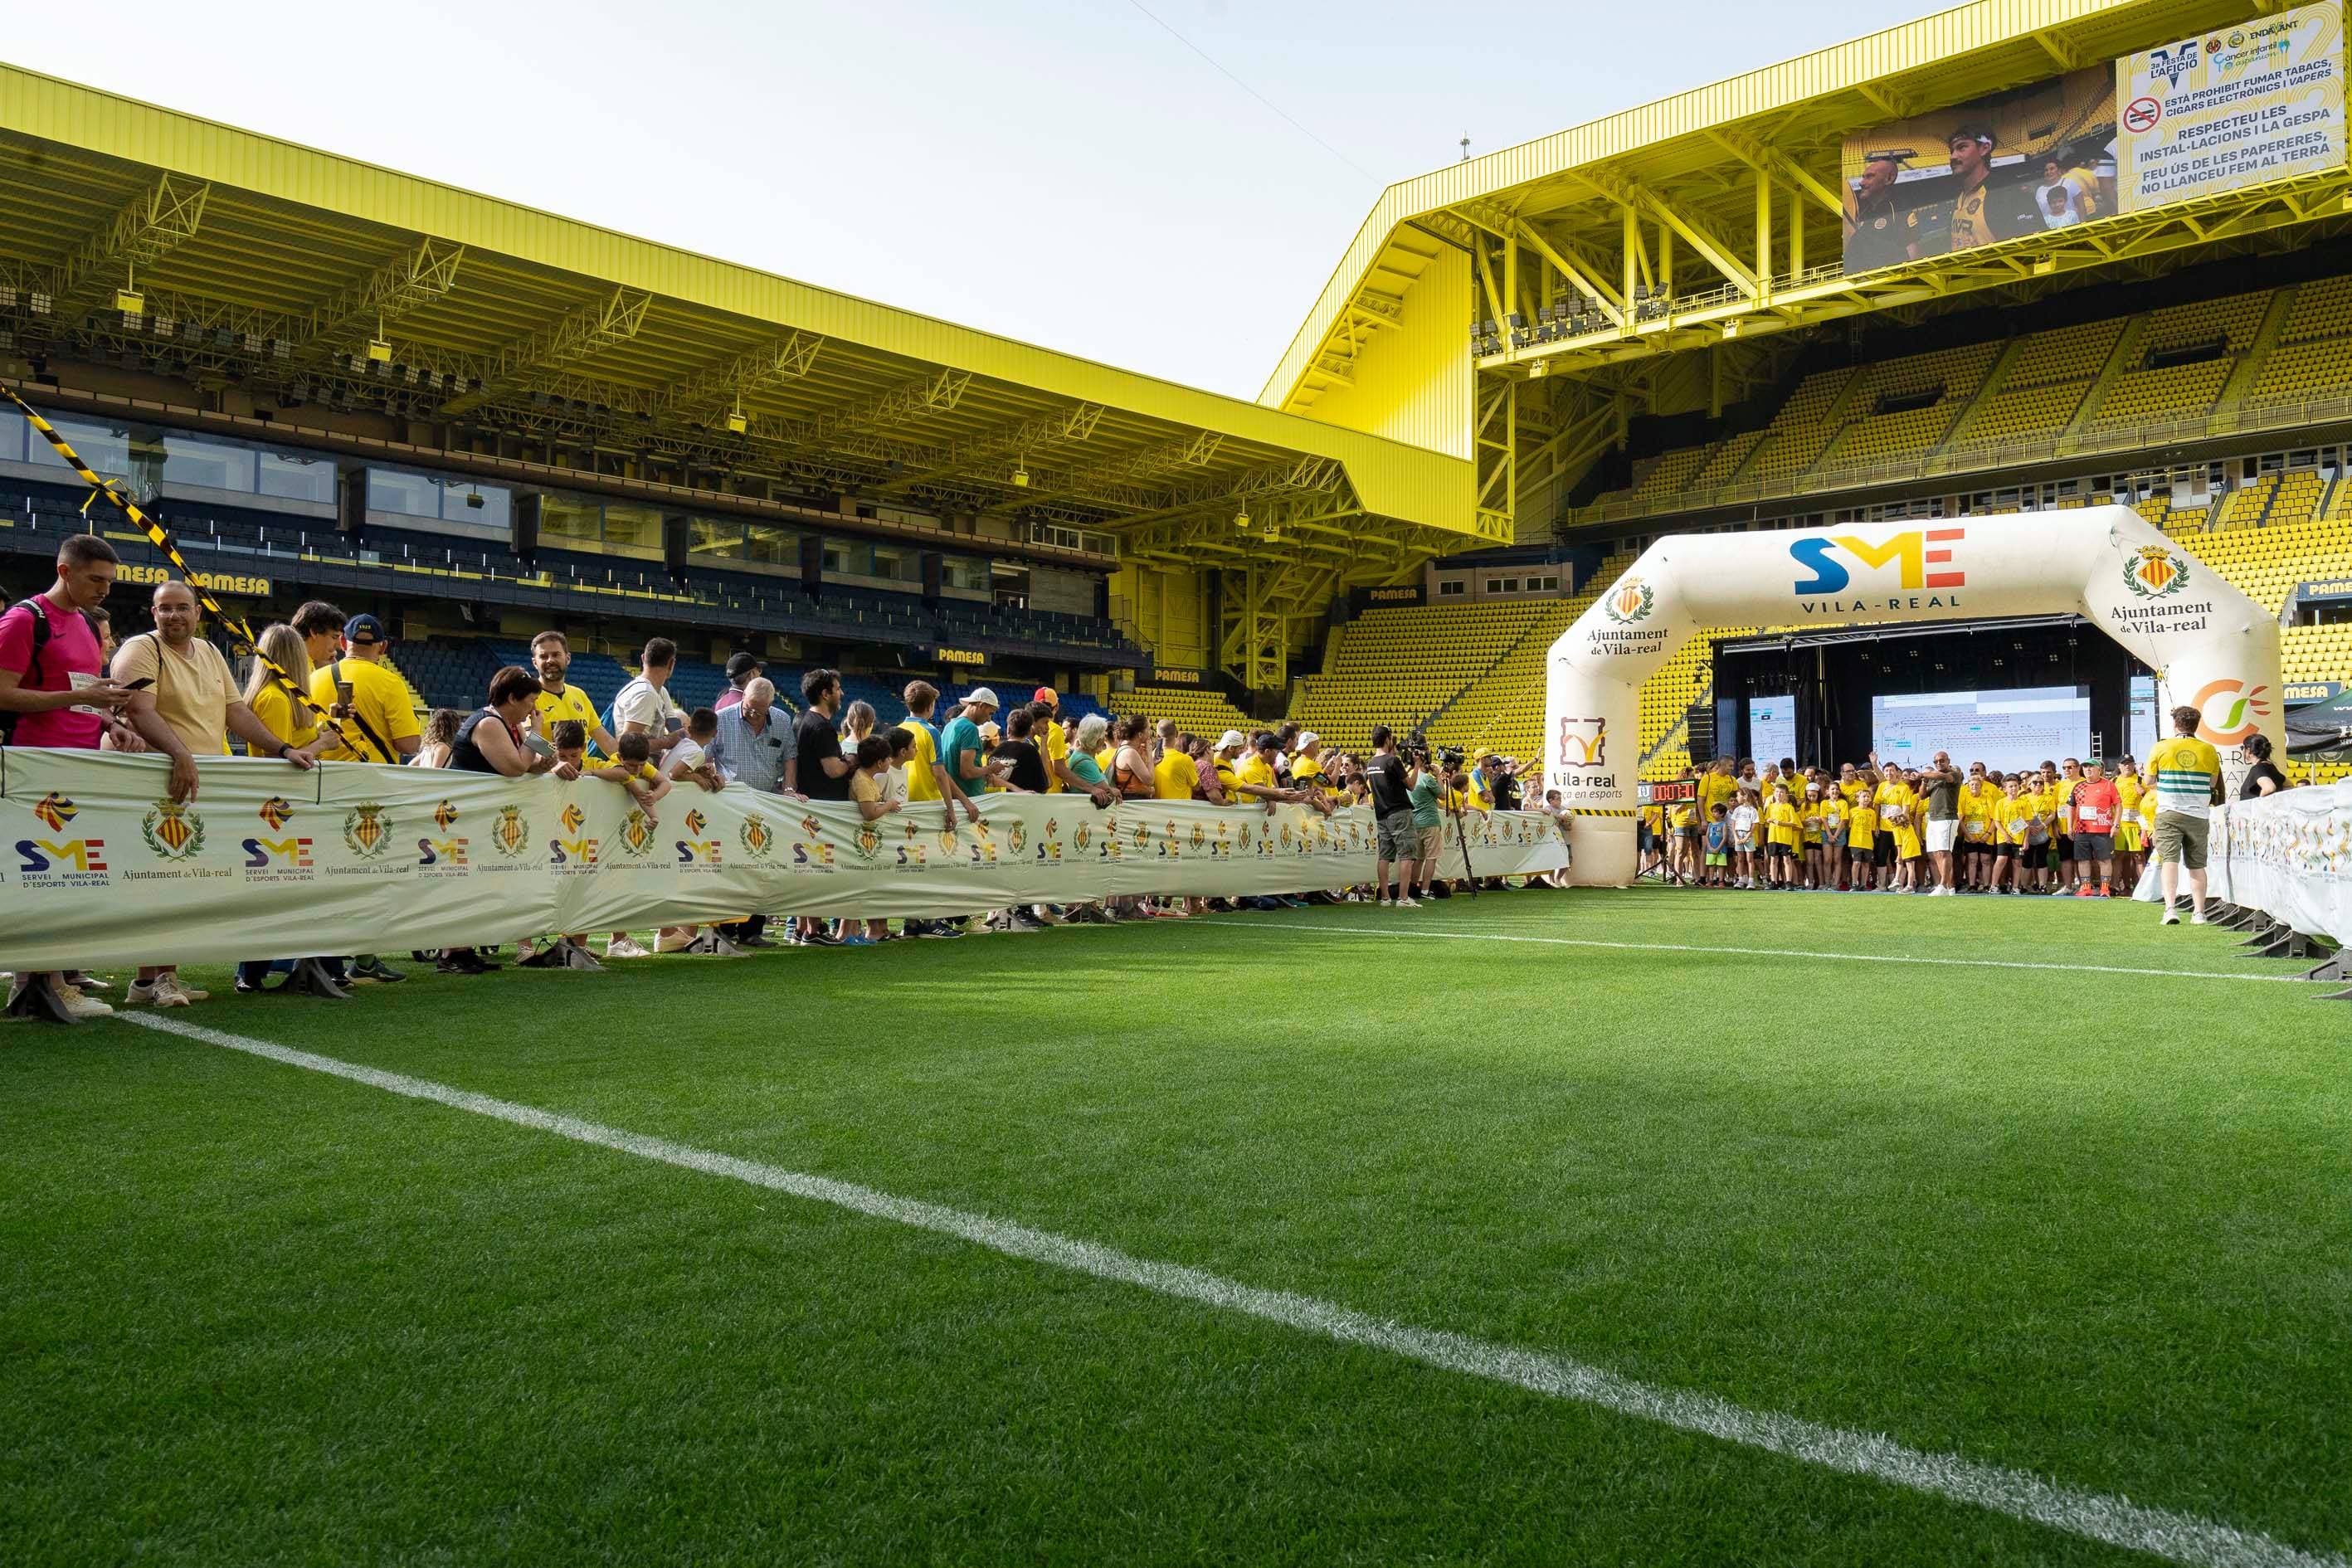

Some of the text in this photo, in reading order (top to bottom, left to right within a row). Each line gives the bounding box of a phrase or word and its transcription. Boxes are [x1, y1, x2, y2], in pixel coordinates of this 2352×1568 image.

[2162, 53, 2186, 66] FESTA
[2193, 81, 2241, 100] PROHIBIT
[2244, 71, 2282, 87] FUMAR
[2285, 59, 2333, 76] TABACS,
[2166, 100, 2204, 117] CIGARS
[2289, 69, 2332, 86] VAPERS
[2178, 105, 2287, 140] RESPECTEU LES
[2262, 120, 2281, 134] LA
[2283, 109, 2330, 128] GESPA
[2143, 131, 2328, 182] FEU ÚS DE LES PAPERERES,
[2141, 182, 2160, 195] NO
[2164, 167, 2226, 190] LLANCEU
[2229, 159, 2257, 175] FEM
[2261, 155, 2277, 169] AL
[1790, 528, 1965, 595] SME
[115, 564, 170, 584] MESA
[1371, 588, 1417, 601] PAMESA
[2309, 582, 2352, 596] PAME
[1801, 596, 1961, 615] VILA-REAL
[2111, 601, 2213, 621] Ajuntament
[2120, 616, 2207, 633] de Vila-real
[1587, 628, 1669, 644] Ajuntament
[938, 649, 985, 664] PAMESA
[1603, 641, 1662, 655] Vila-real
[1155, 670, 1200, 683] PAMESA
[2283, 686, 2329, 699] MESA
[1553, 772, 1616, 787] Vila-real
[1590, 790, 1623, 800] esports
[15, 839, 107, 872] SME
[241, 838, 314, 868] SME
[417, 838, 469, 864] SME
[549, 839, 598, 863] SME
[675, 840, 722, 863] SME
[122, 869, 182, 881] Ajuntament
[191, 867, 232, 878] Vila-real
[324, 866, 371, 876] Ajuntament
[378, 864, 409, 874] Vila-real
[476, 864, 514, 874] Ajuntament
[519, 863, 543, 871] Vila-real
